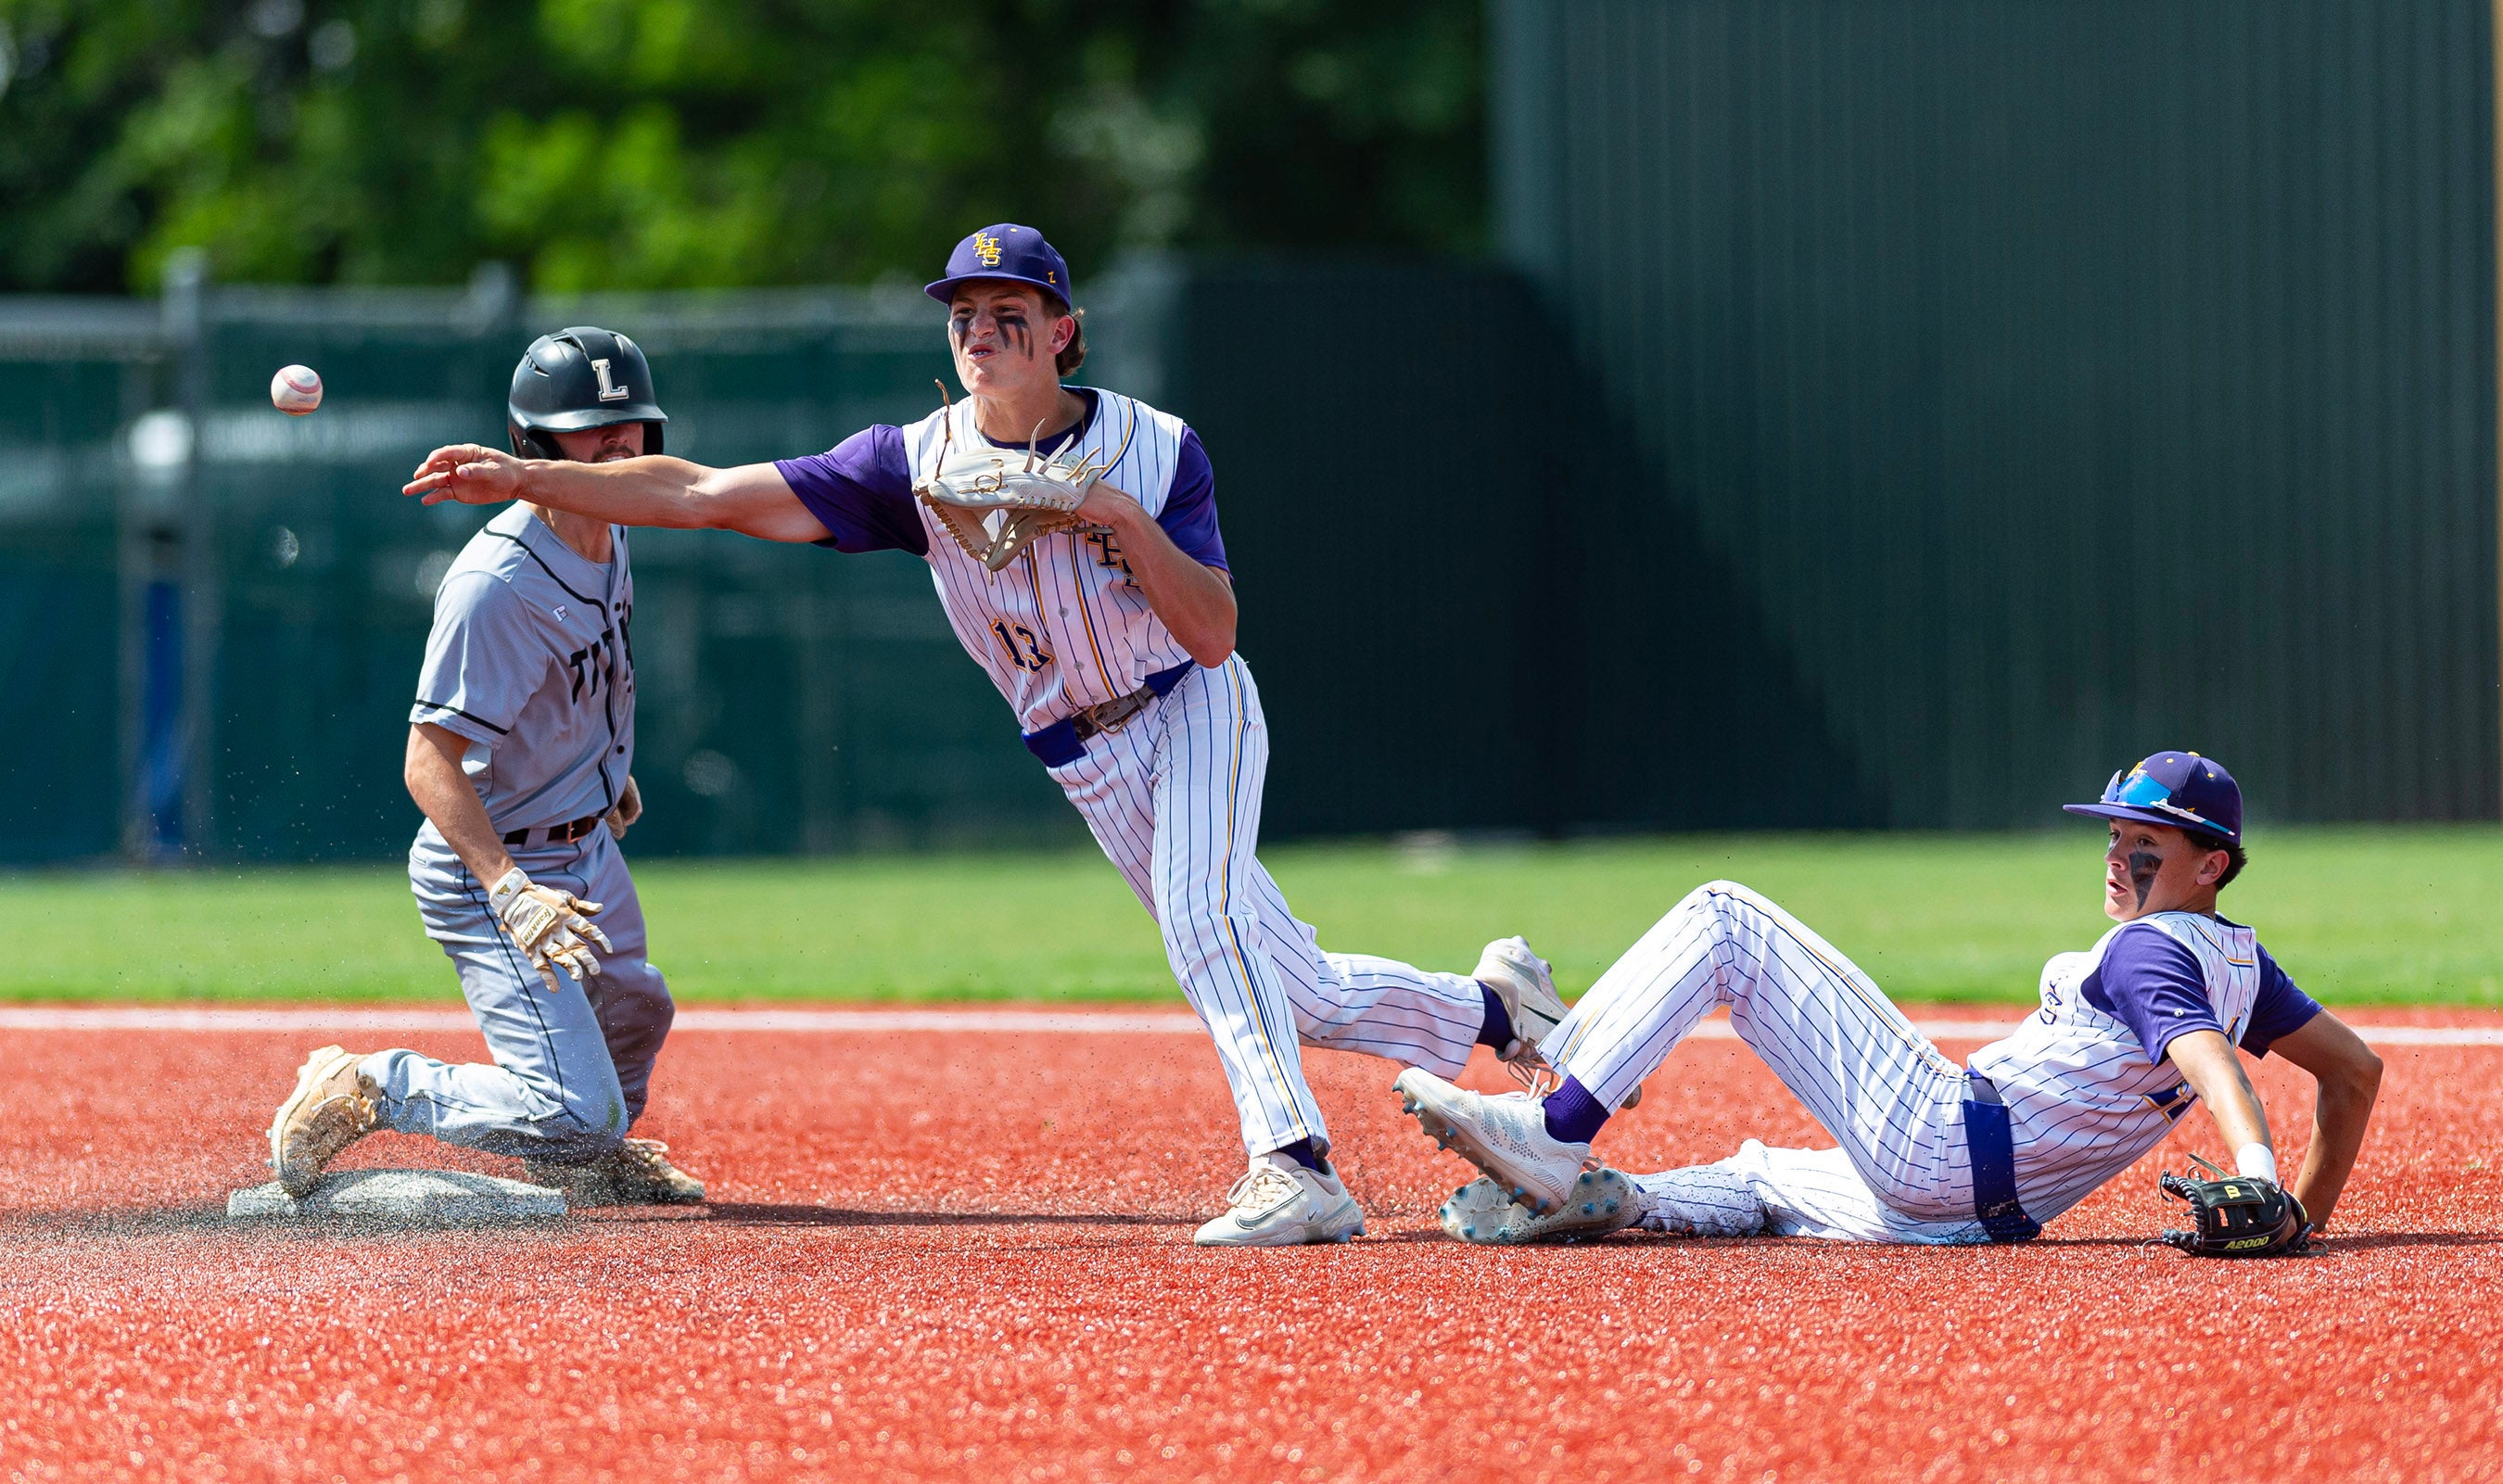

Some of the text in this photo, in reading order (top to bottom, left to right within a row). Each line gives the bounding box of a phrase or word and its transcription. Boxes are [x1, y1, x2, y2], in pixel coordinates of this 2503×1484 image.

[972, 233, 1001, 267] LHS
[591, 358, 629, 402] L
[569, 602, 635, 705] TITA
[989, 618, 1055, 675] 13
[2224, 1235, 2269, 1249] A2000
